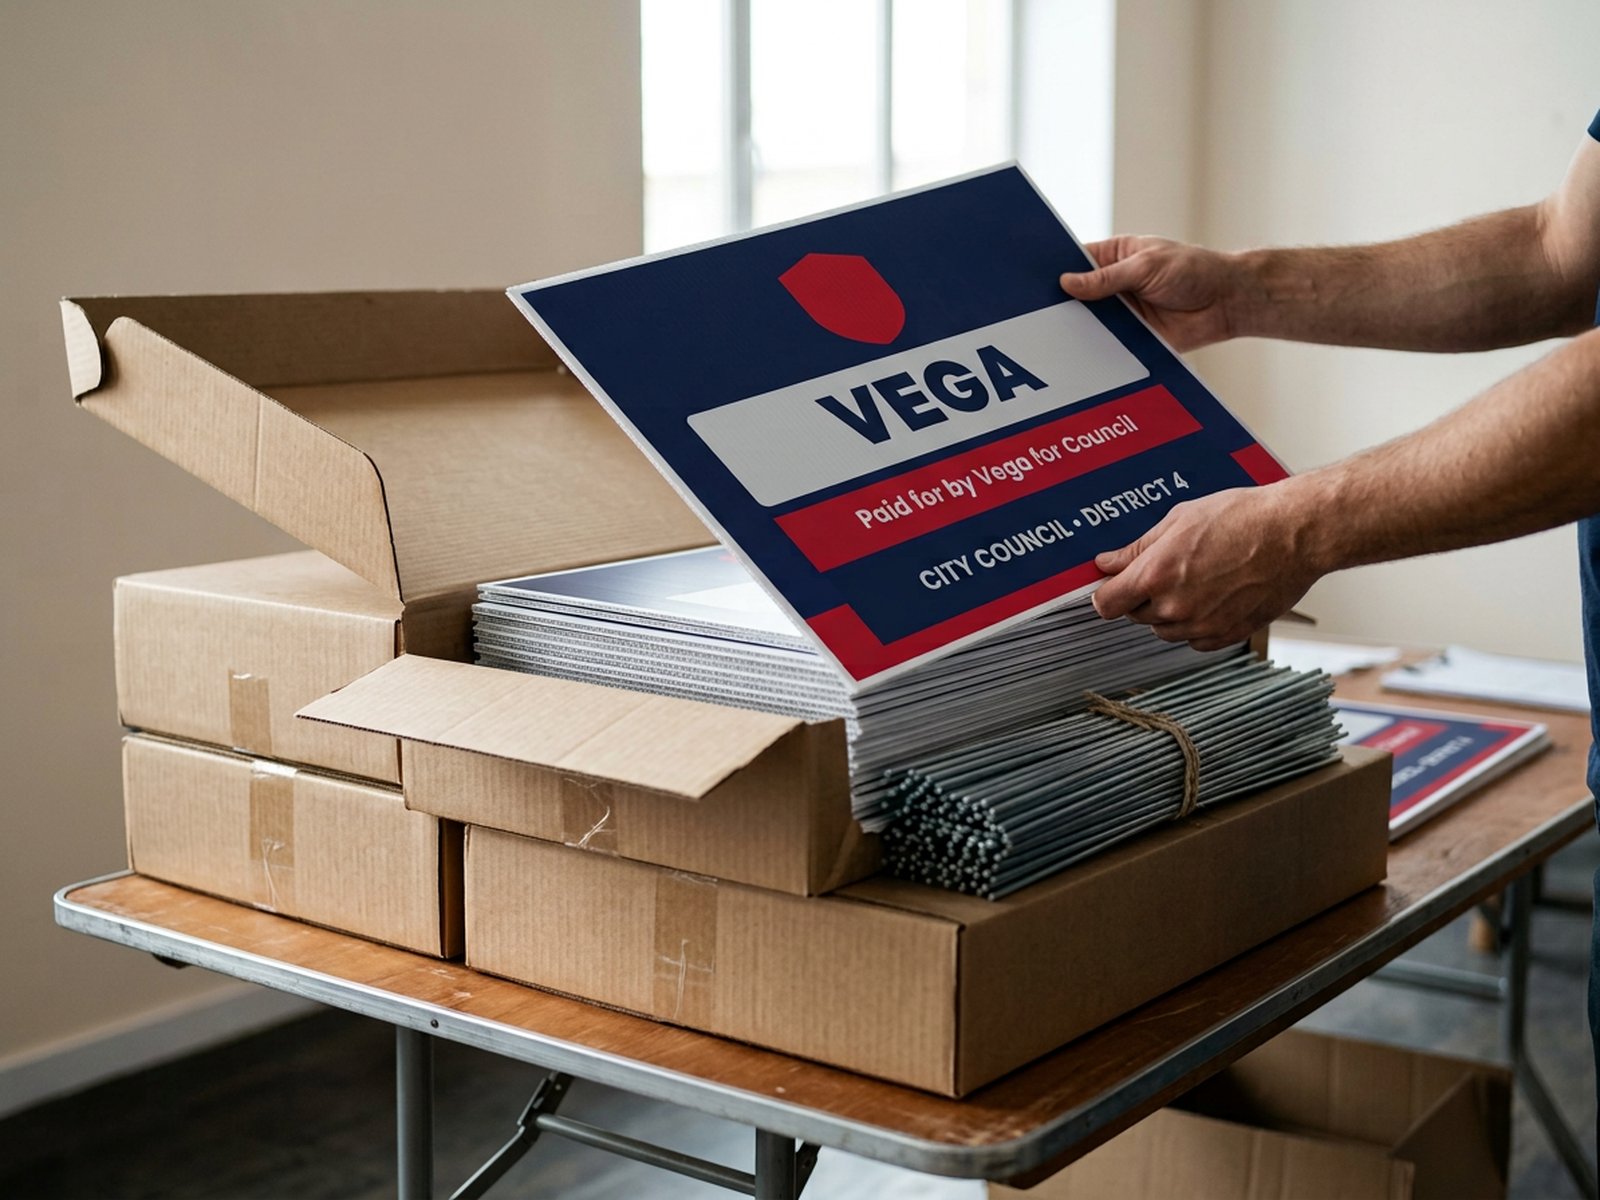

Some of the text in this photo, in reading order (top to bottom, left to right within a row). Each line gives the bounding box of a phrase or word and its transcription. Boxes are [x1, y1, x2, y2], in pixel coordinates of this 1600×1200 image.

[815, 344, 1049, 445] VEGA
[855, 414, 1139, 529] Paid for by Vega for Council
[919, 555, 974, 590] CITY
[973, 519, 1075, 569] COUNCIL
[1079, 478, 1172, 527] DISTRICT
[1173, 471, 1190, 489] 4
